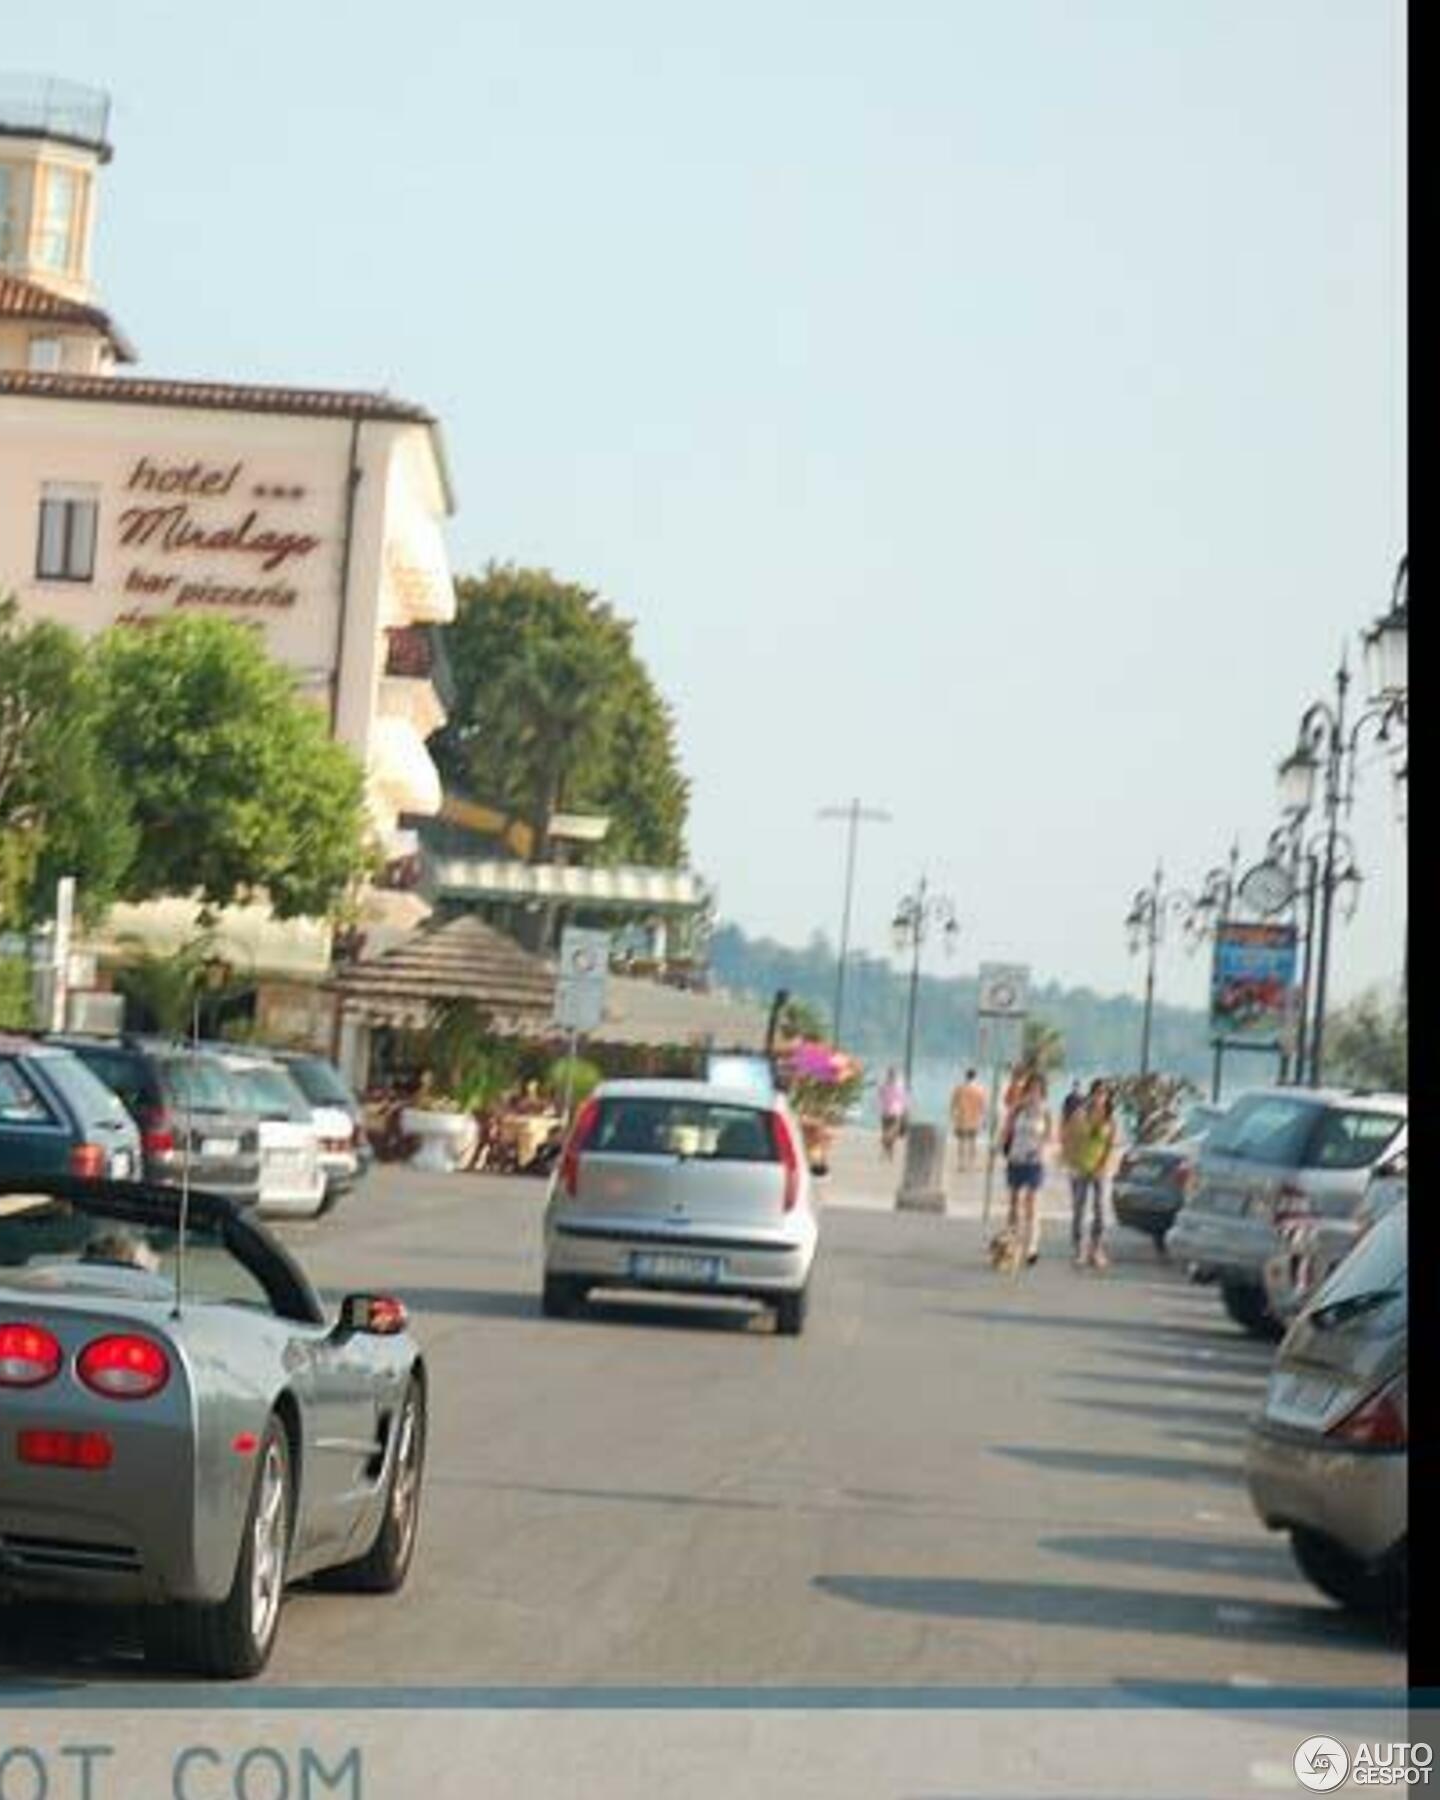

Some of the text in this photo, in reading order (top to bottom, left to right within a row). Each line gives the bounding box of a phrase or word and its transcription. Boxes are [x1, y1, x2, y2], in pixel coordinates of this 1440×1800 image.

[127, 456, 243, 496] hotel
[117, 503, 321, 572] Miralago
[125, 567, 298, 608] bar pizzeria
